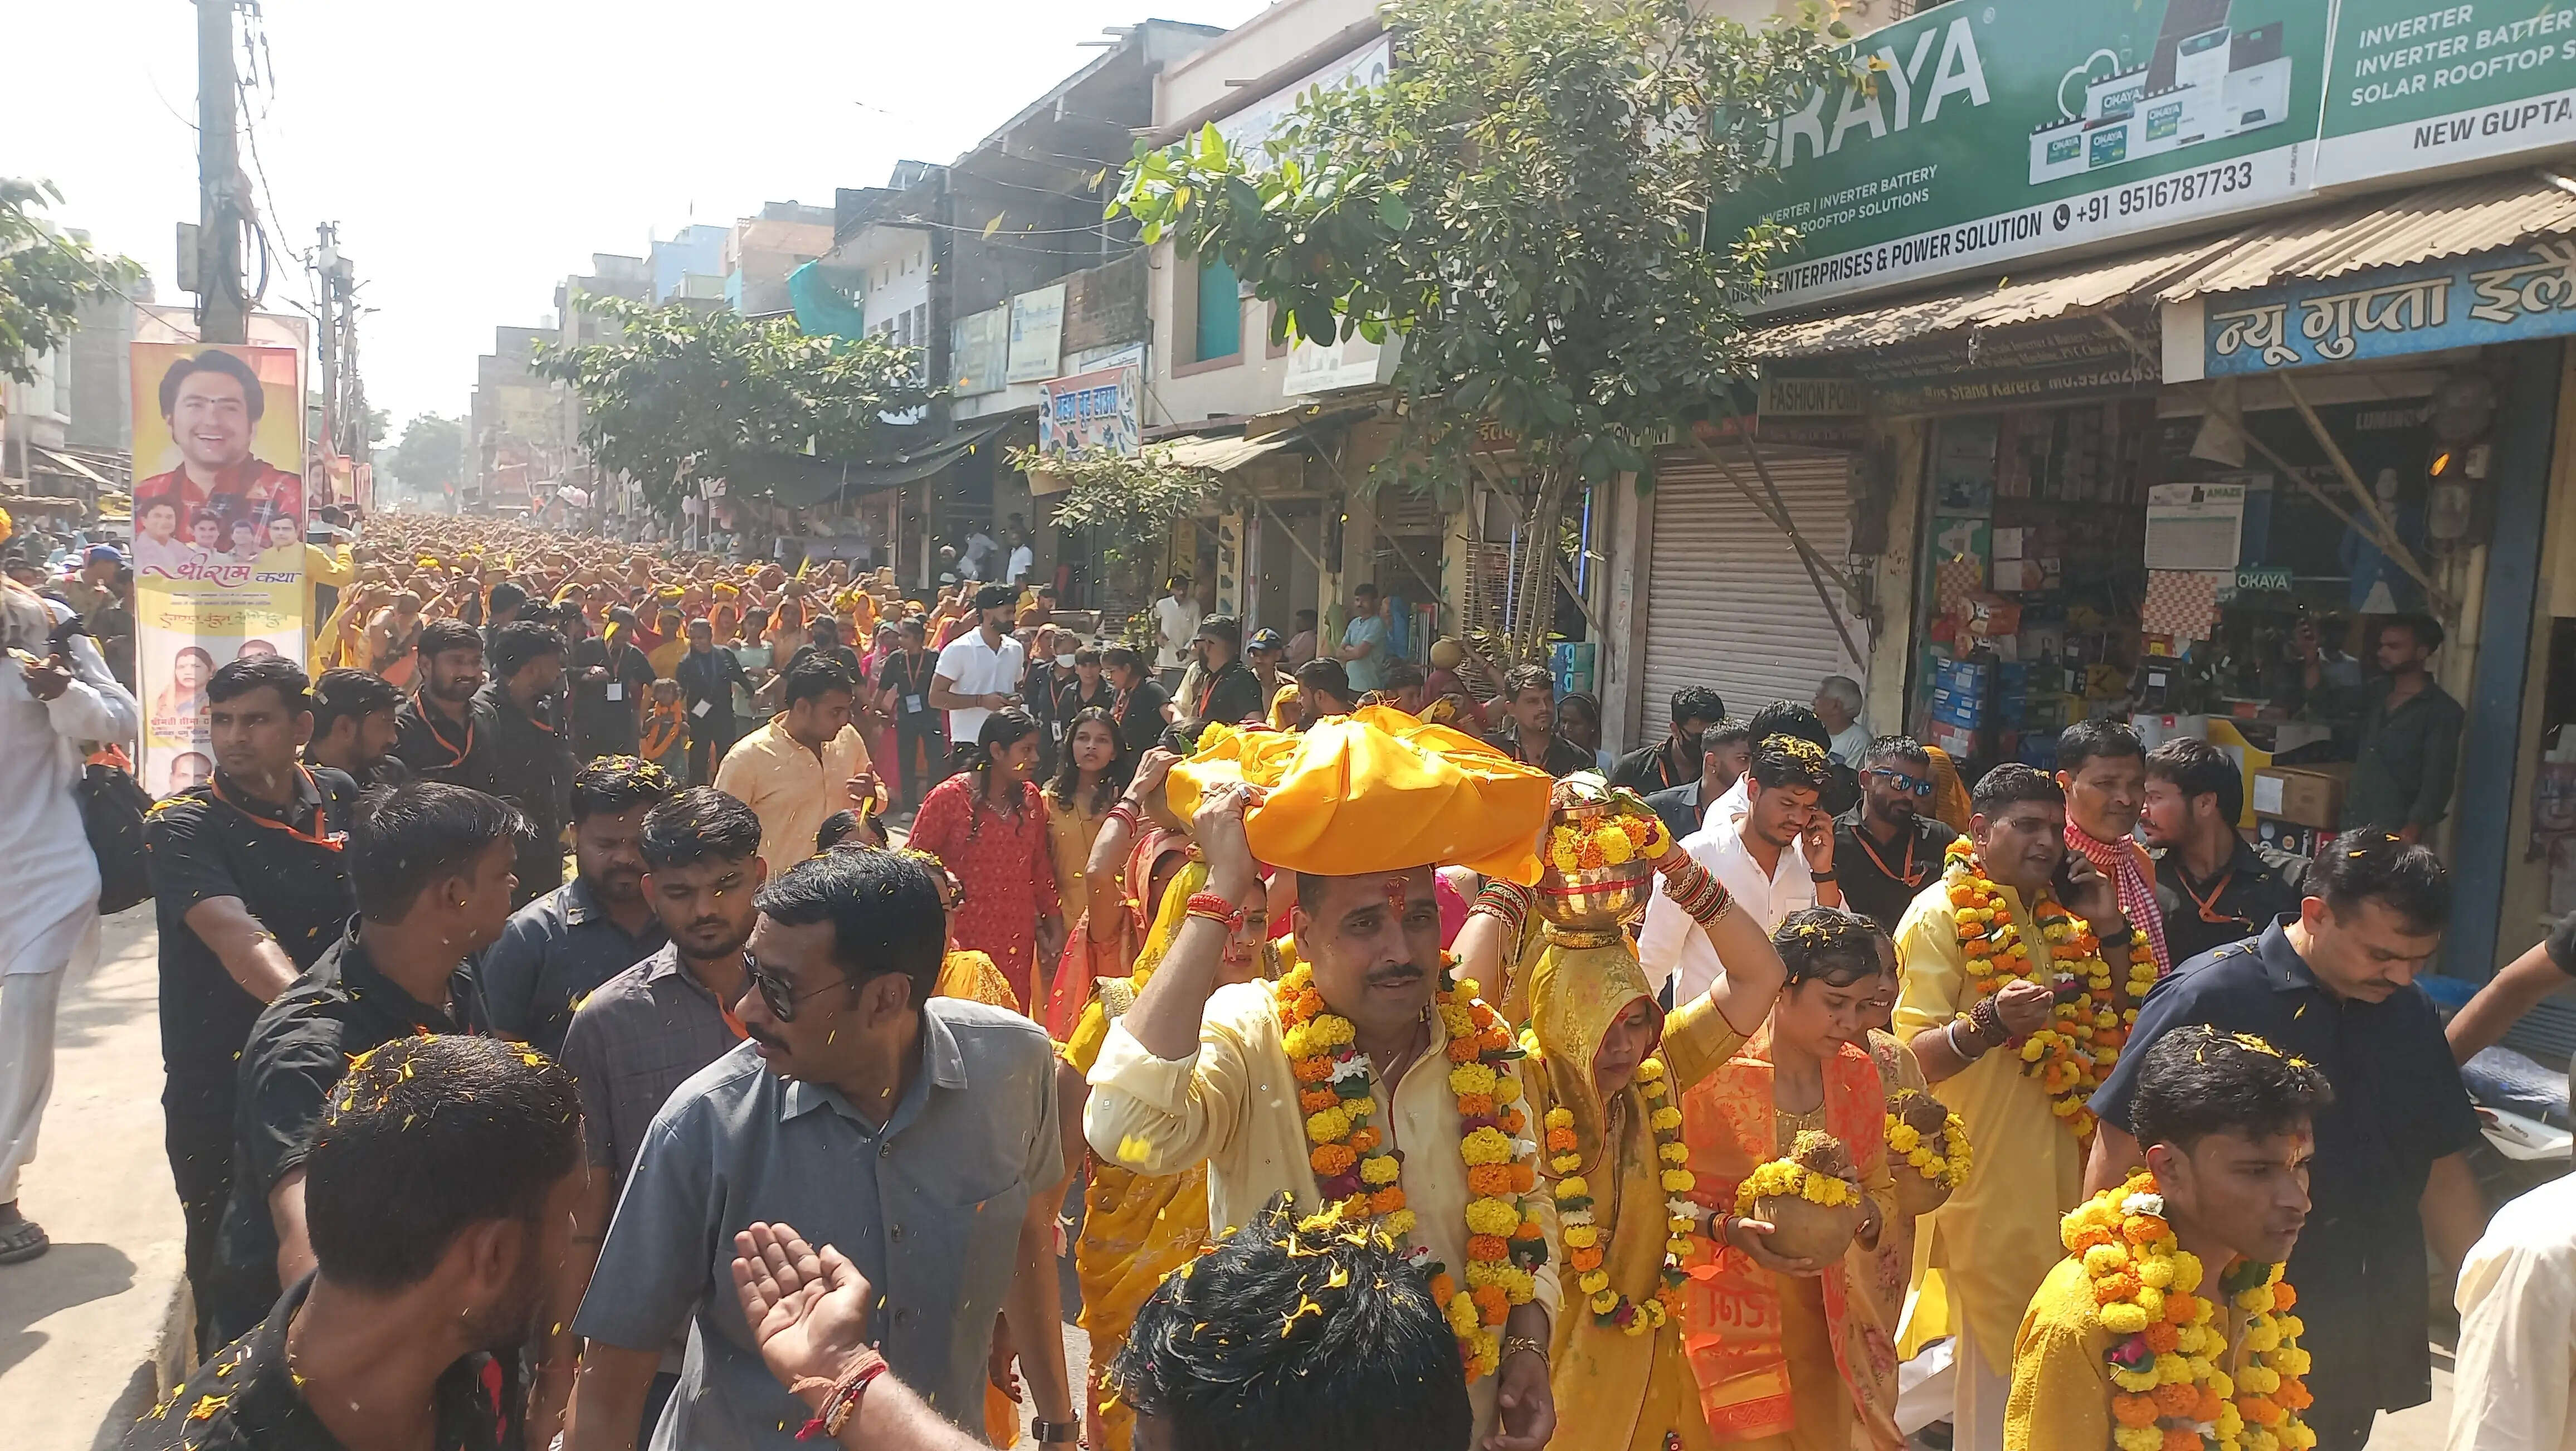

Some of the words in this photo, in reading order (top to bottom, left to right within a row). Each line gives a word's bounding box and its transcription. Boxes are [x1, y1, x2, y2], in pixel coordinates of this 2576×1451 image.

[2359, 4, 2473, 48] INVERTER
[2350, 74, 2427, 106] SOLAR
[2433, 45, 2555, 89] ROOFTOP
[2355, 35, 2468, 77] INVERTER
[2413, 116, 2476, 149] NEW
[2482, 97, 2572, 136] GUPTA
[1759, 202, 1811, 226] INVERTER
[1820, 182, 1877, 210] INVERTER
[1881, 164, 1938, 192] BATTERY
[1801, 208, 1856, 233] ROOFTOP
[1859, 188, 1929, 218] SOLUTIONS
[1777, 254, 1872, 294] ENTERPRISES
[1877, 248, 1887, 271] &
[1892, 233, 1950, 269] POWER
[1955, 211, 2042, 254] SOLUTION
[2077, 194, 2109, 222] +91
[2120, 162, 2252, 216] 9516787733
[2212, 303, 2300, 366] न्यू
[2300, 275, 2455, 361] गुप्ता
[1770, 382, 1824, 411] FASHION
[142, 553, 251, 588] श्रीराम
[255, 572, 302, 583] कथा
[2238, 573, 2288, 589] OKAYA
